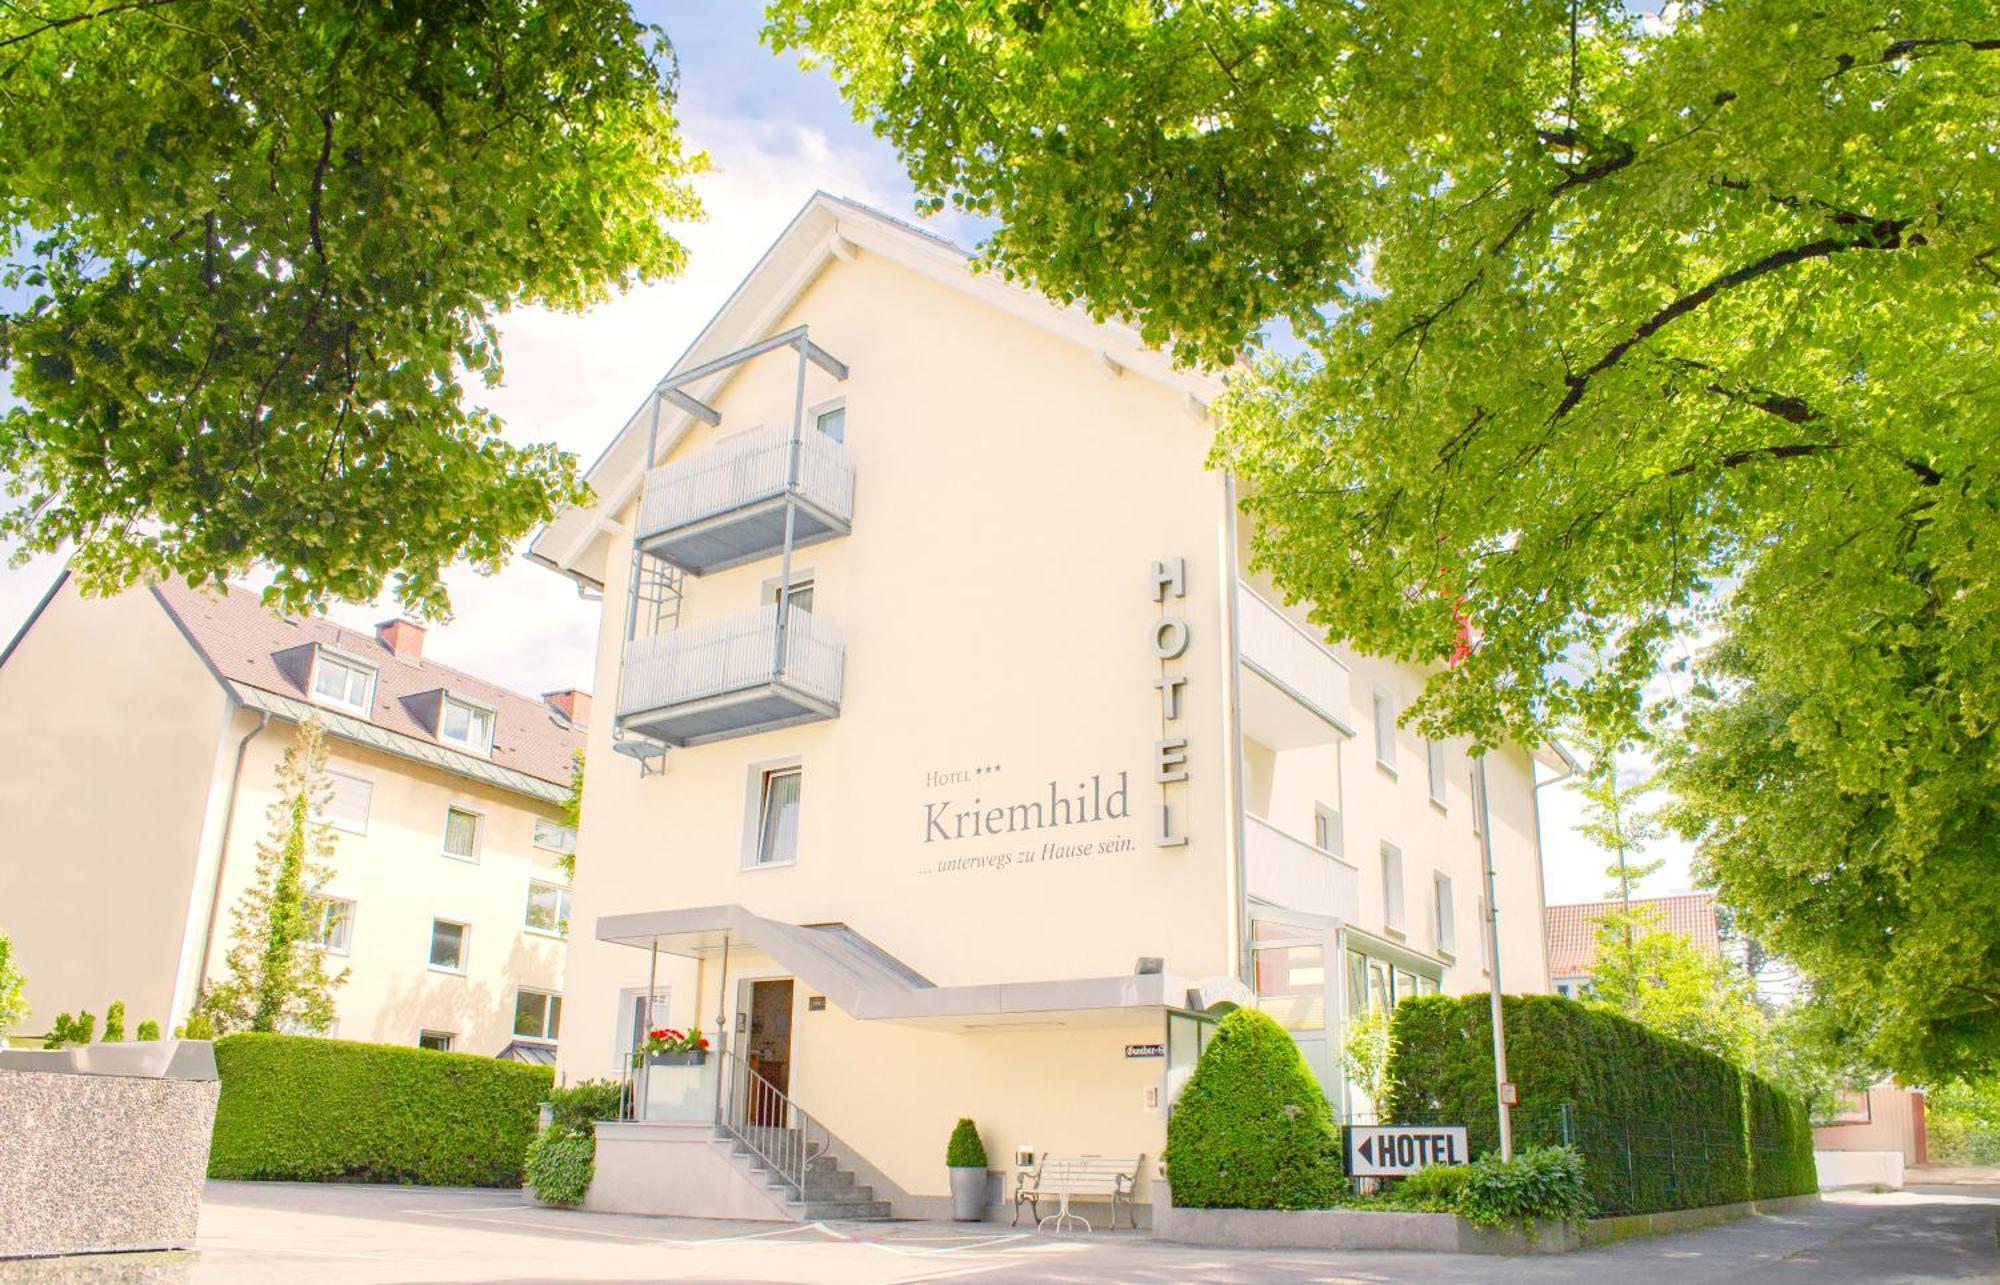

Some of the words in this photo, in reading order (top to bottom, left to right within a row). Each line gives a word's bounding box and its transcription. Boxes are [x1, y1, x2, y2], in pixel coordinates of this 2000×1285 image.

[1152, 556, 1189, 848] HOTEL
[922, 771, 1131, 842] Kriemhild
[938, 852, 1012, 871] unterwegs
[1016, 850, 1035, 863] zu
[1041, 842, 1093, 861] Hause
[1097, 834, 1136, 854] sein.
[1378, 1134, 1462, 1167] HOTEL
